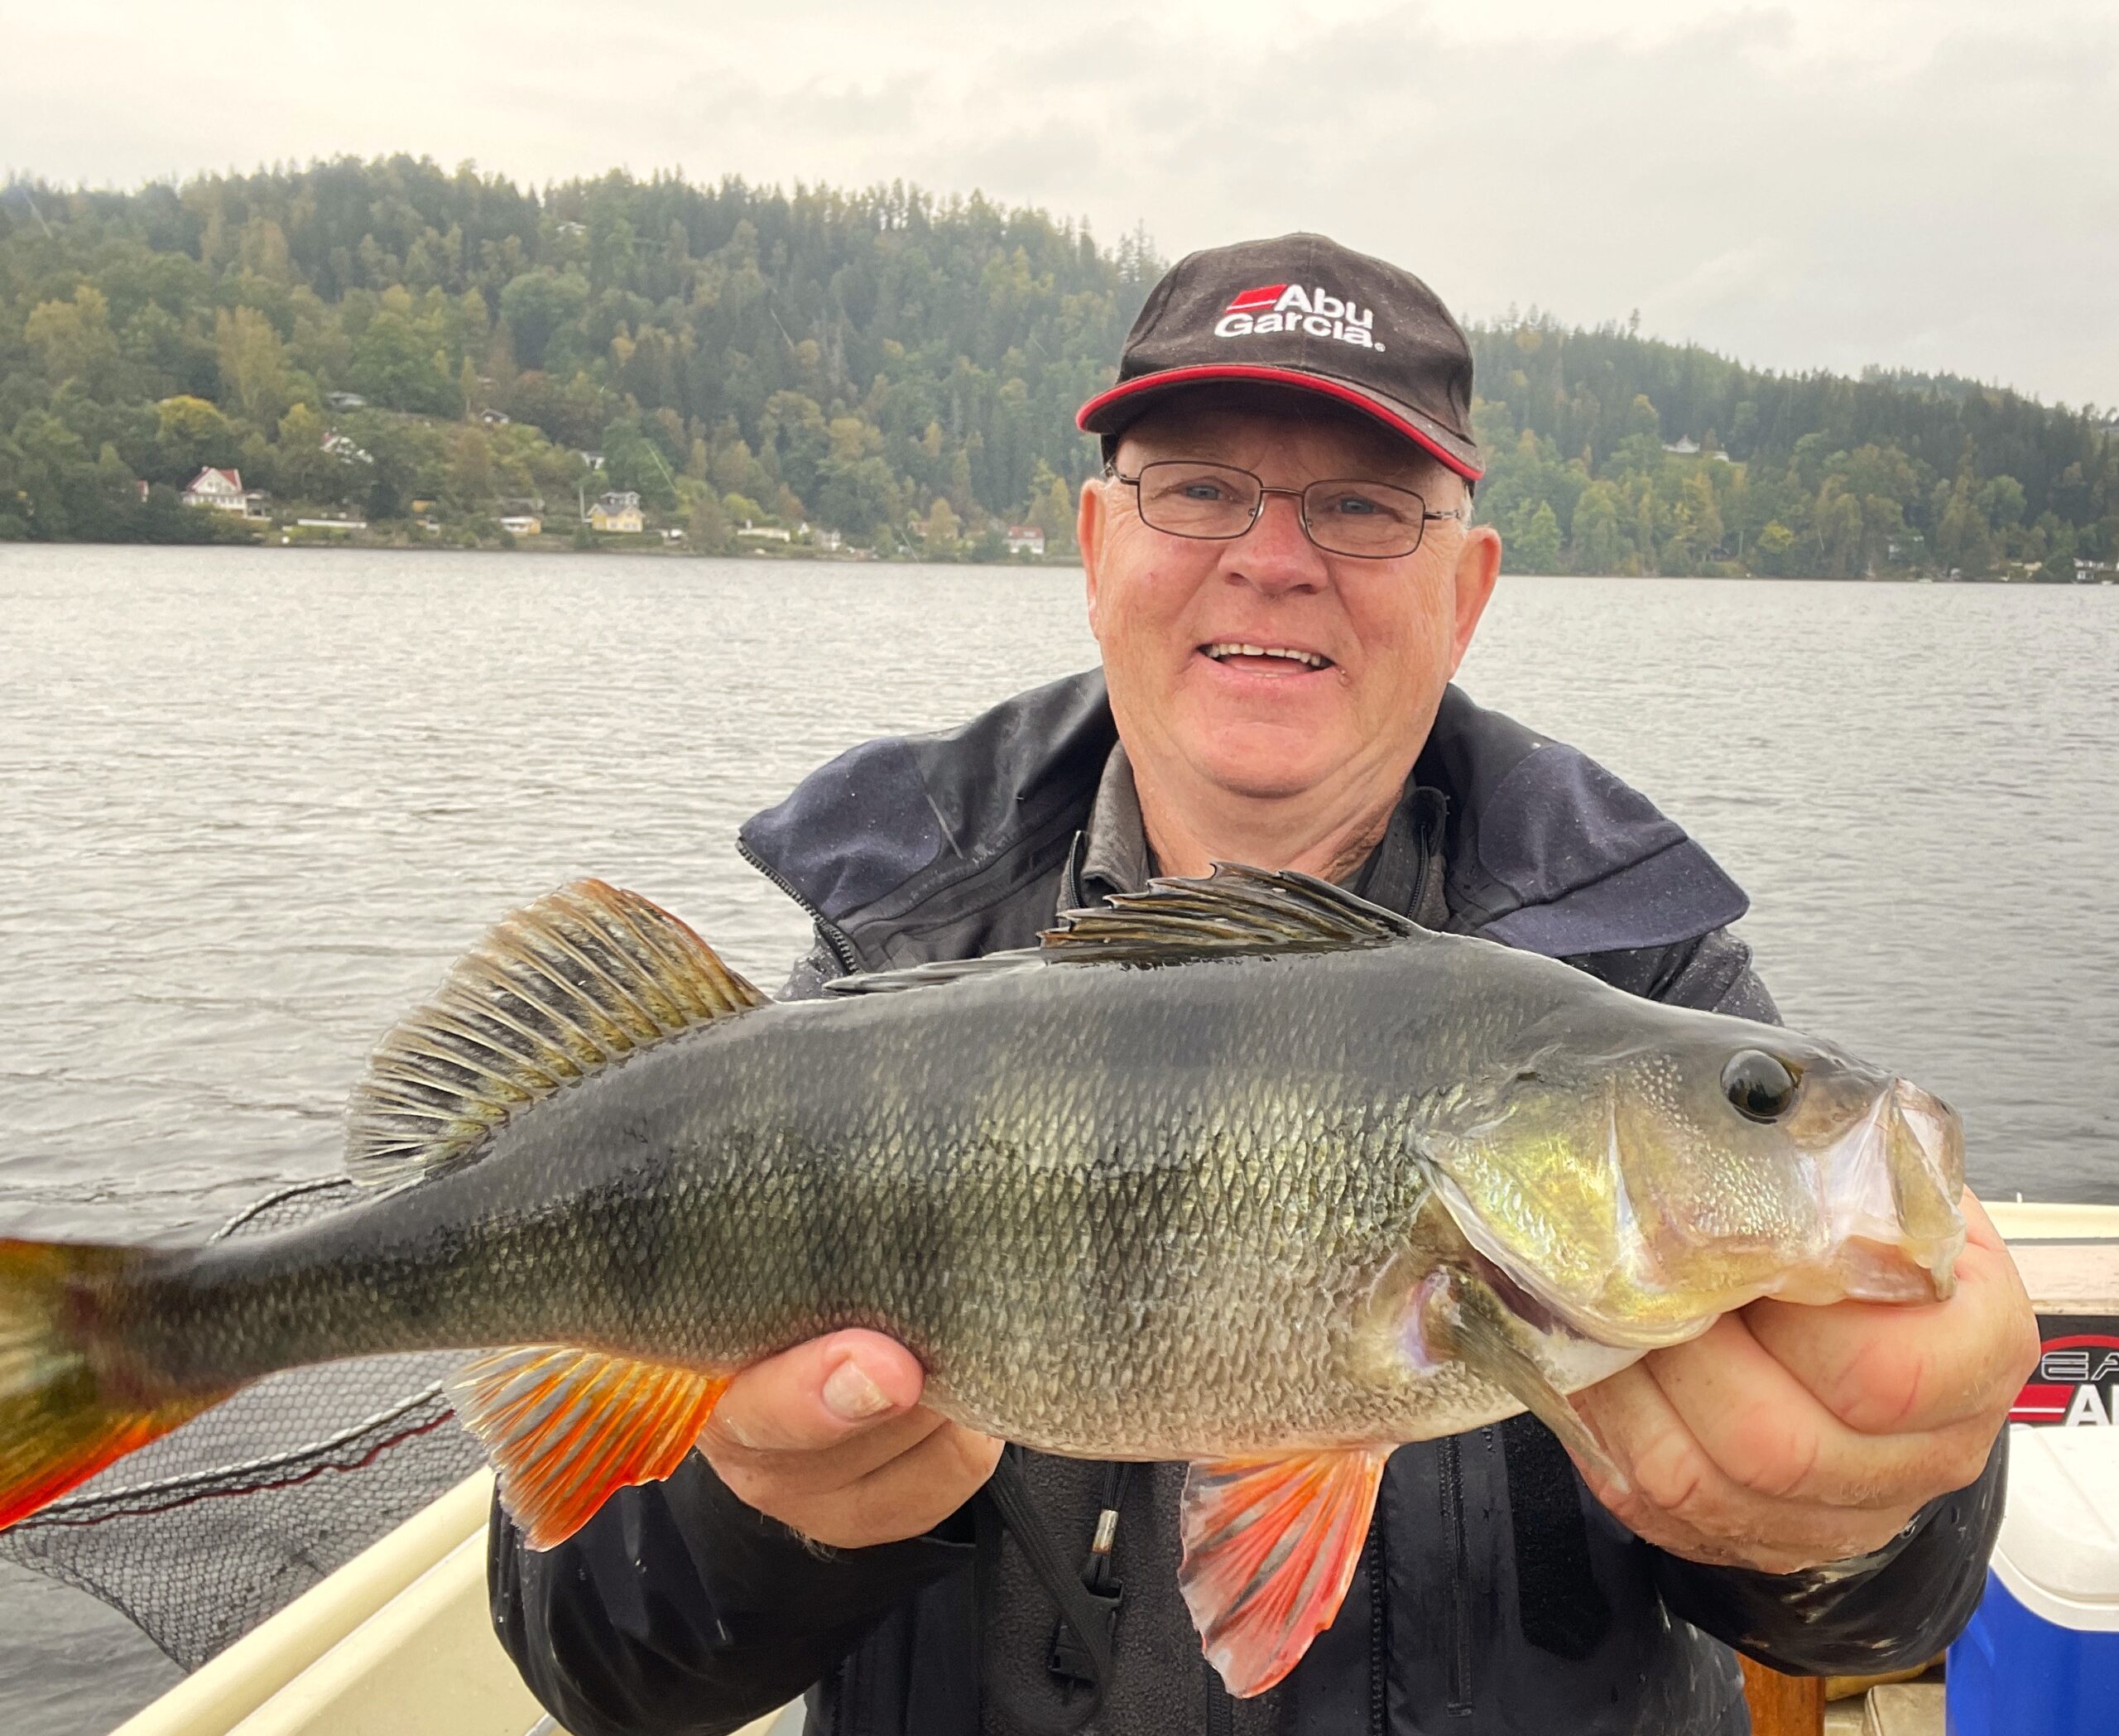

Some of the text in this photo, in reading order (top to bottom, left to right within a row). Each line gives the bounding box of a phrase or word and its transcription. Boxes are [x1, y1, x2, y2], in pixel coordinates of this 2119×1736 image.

[1273, 284, 1374, 329] Abu
[1213, 311, 1374, 349] Garcia
[2065, 1383, 2119, 1427] A
